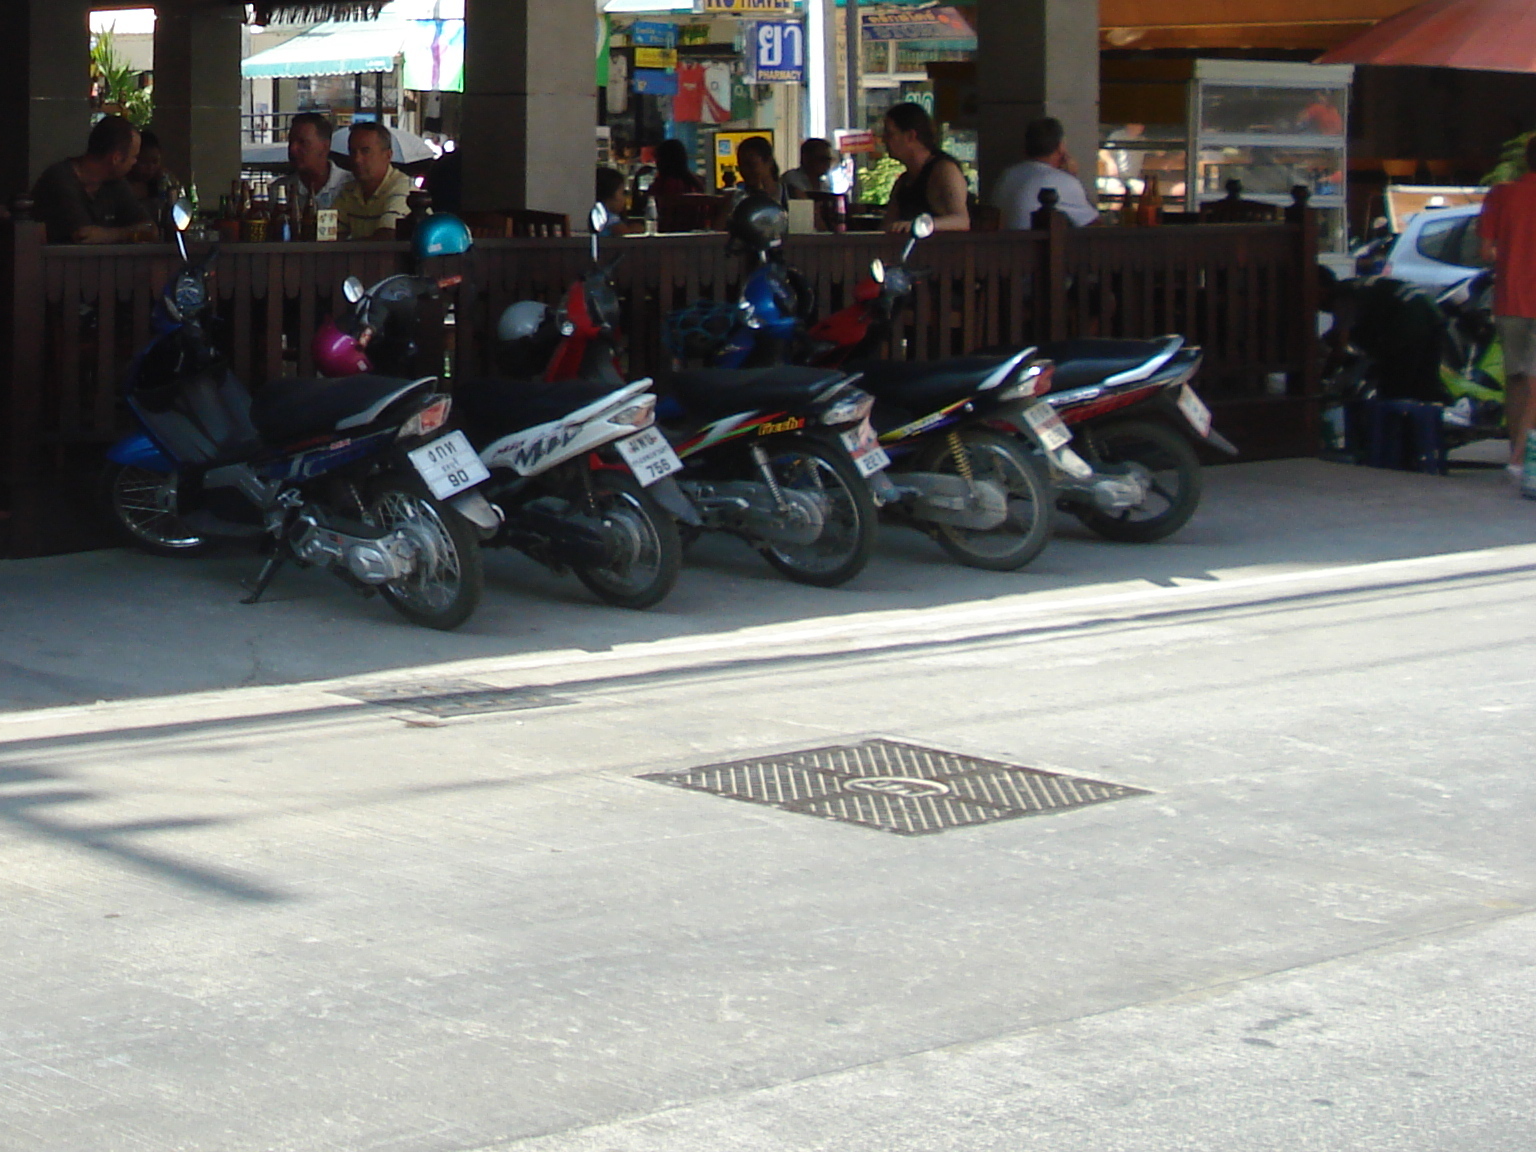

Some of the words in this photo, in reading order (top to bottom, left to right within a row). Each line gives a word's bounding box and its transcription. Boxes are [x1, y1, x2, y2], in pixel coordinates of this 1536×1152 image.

[758, 23, 803, 67] ยา
[757, 69, 803, 81] PHARMACY
[448, 469, 469, 487] 90
[646, 458, 672, 479] 756
